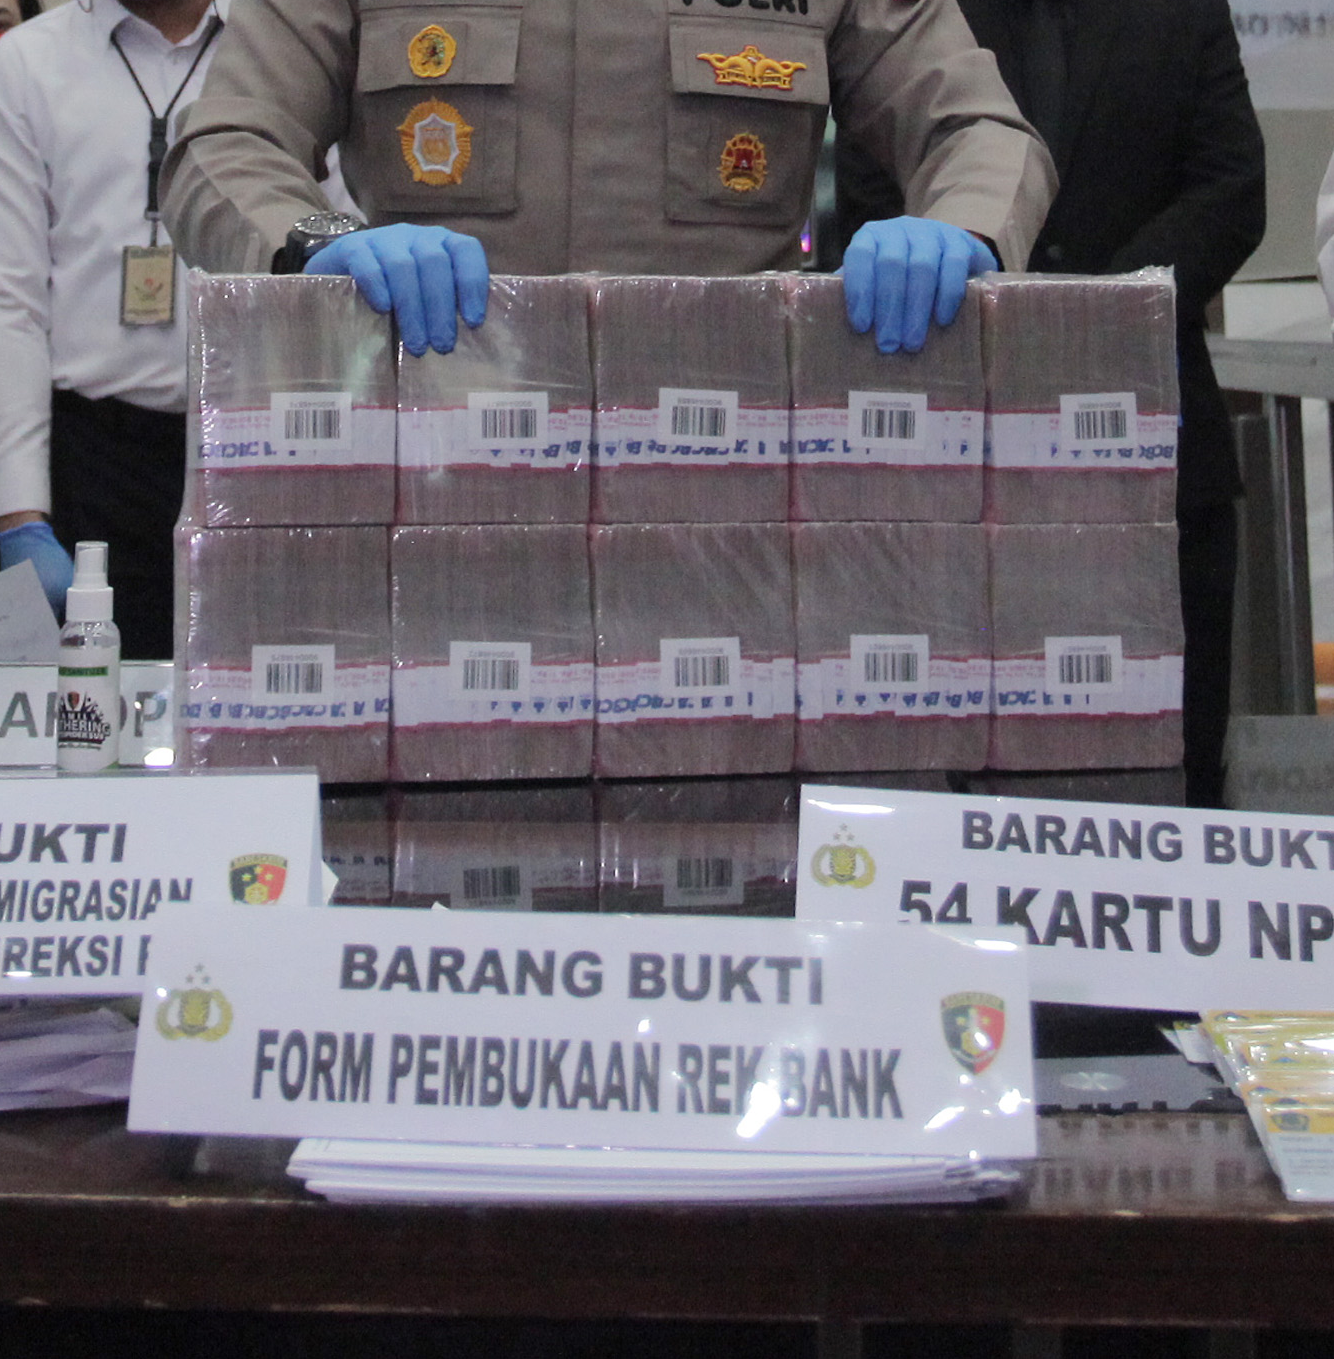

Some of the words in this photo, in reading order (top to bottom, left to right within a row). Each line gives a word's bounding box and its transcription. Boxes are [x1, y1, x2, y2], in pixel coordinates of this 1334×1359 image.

[961, 810, 1183, 862] BARANG
[899, 879, 973, 925] 54
[996, 886, 1222, 957] KARTU
[340, 944, 604, 997] BARANG
[628, 952, 825, 1006] BUKTI
[252, 1028, 375, 1105] FORM
[386, 1034, 662, 1114] PEMBUKAAN
[677, 1043, 773, 1117] REK
[781, 1046, 904, 1120] BANK
